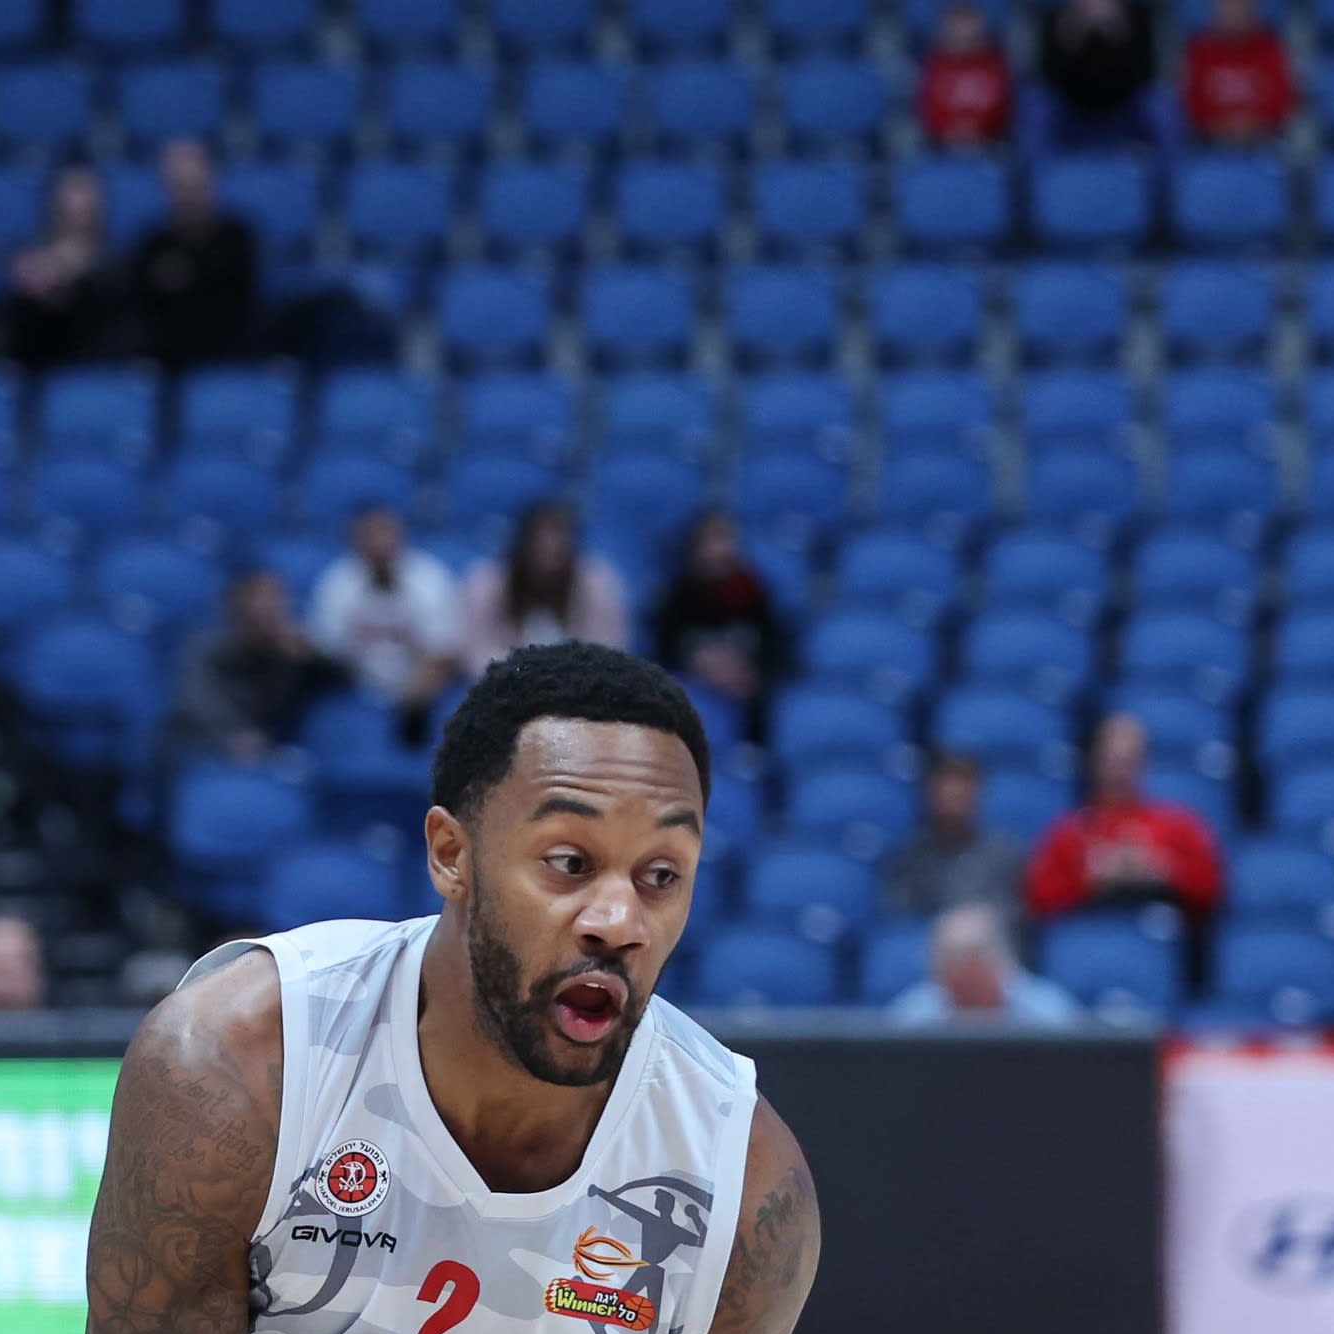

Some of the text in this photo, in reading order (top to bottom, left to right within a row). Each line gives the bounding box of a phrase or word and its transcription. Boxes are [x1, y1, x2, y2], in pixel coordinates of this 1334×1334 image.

[360, 1141, 385, 1166] הפועל
[290, 1224, 398, 1254] GIVOVA
[556, 1287, 636, 1322] Winner סל
[595, 1291, 619, 1305] ליגת
